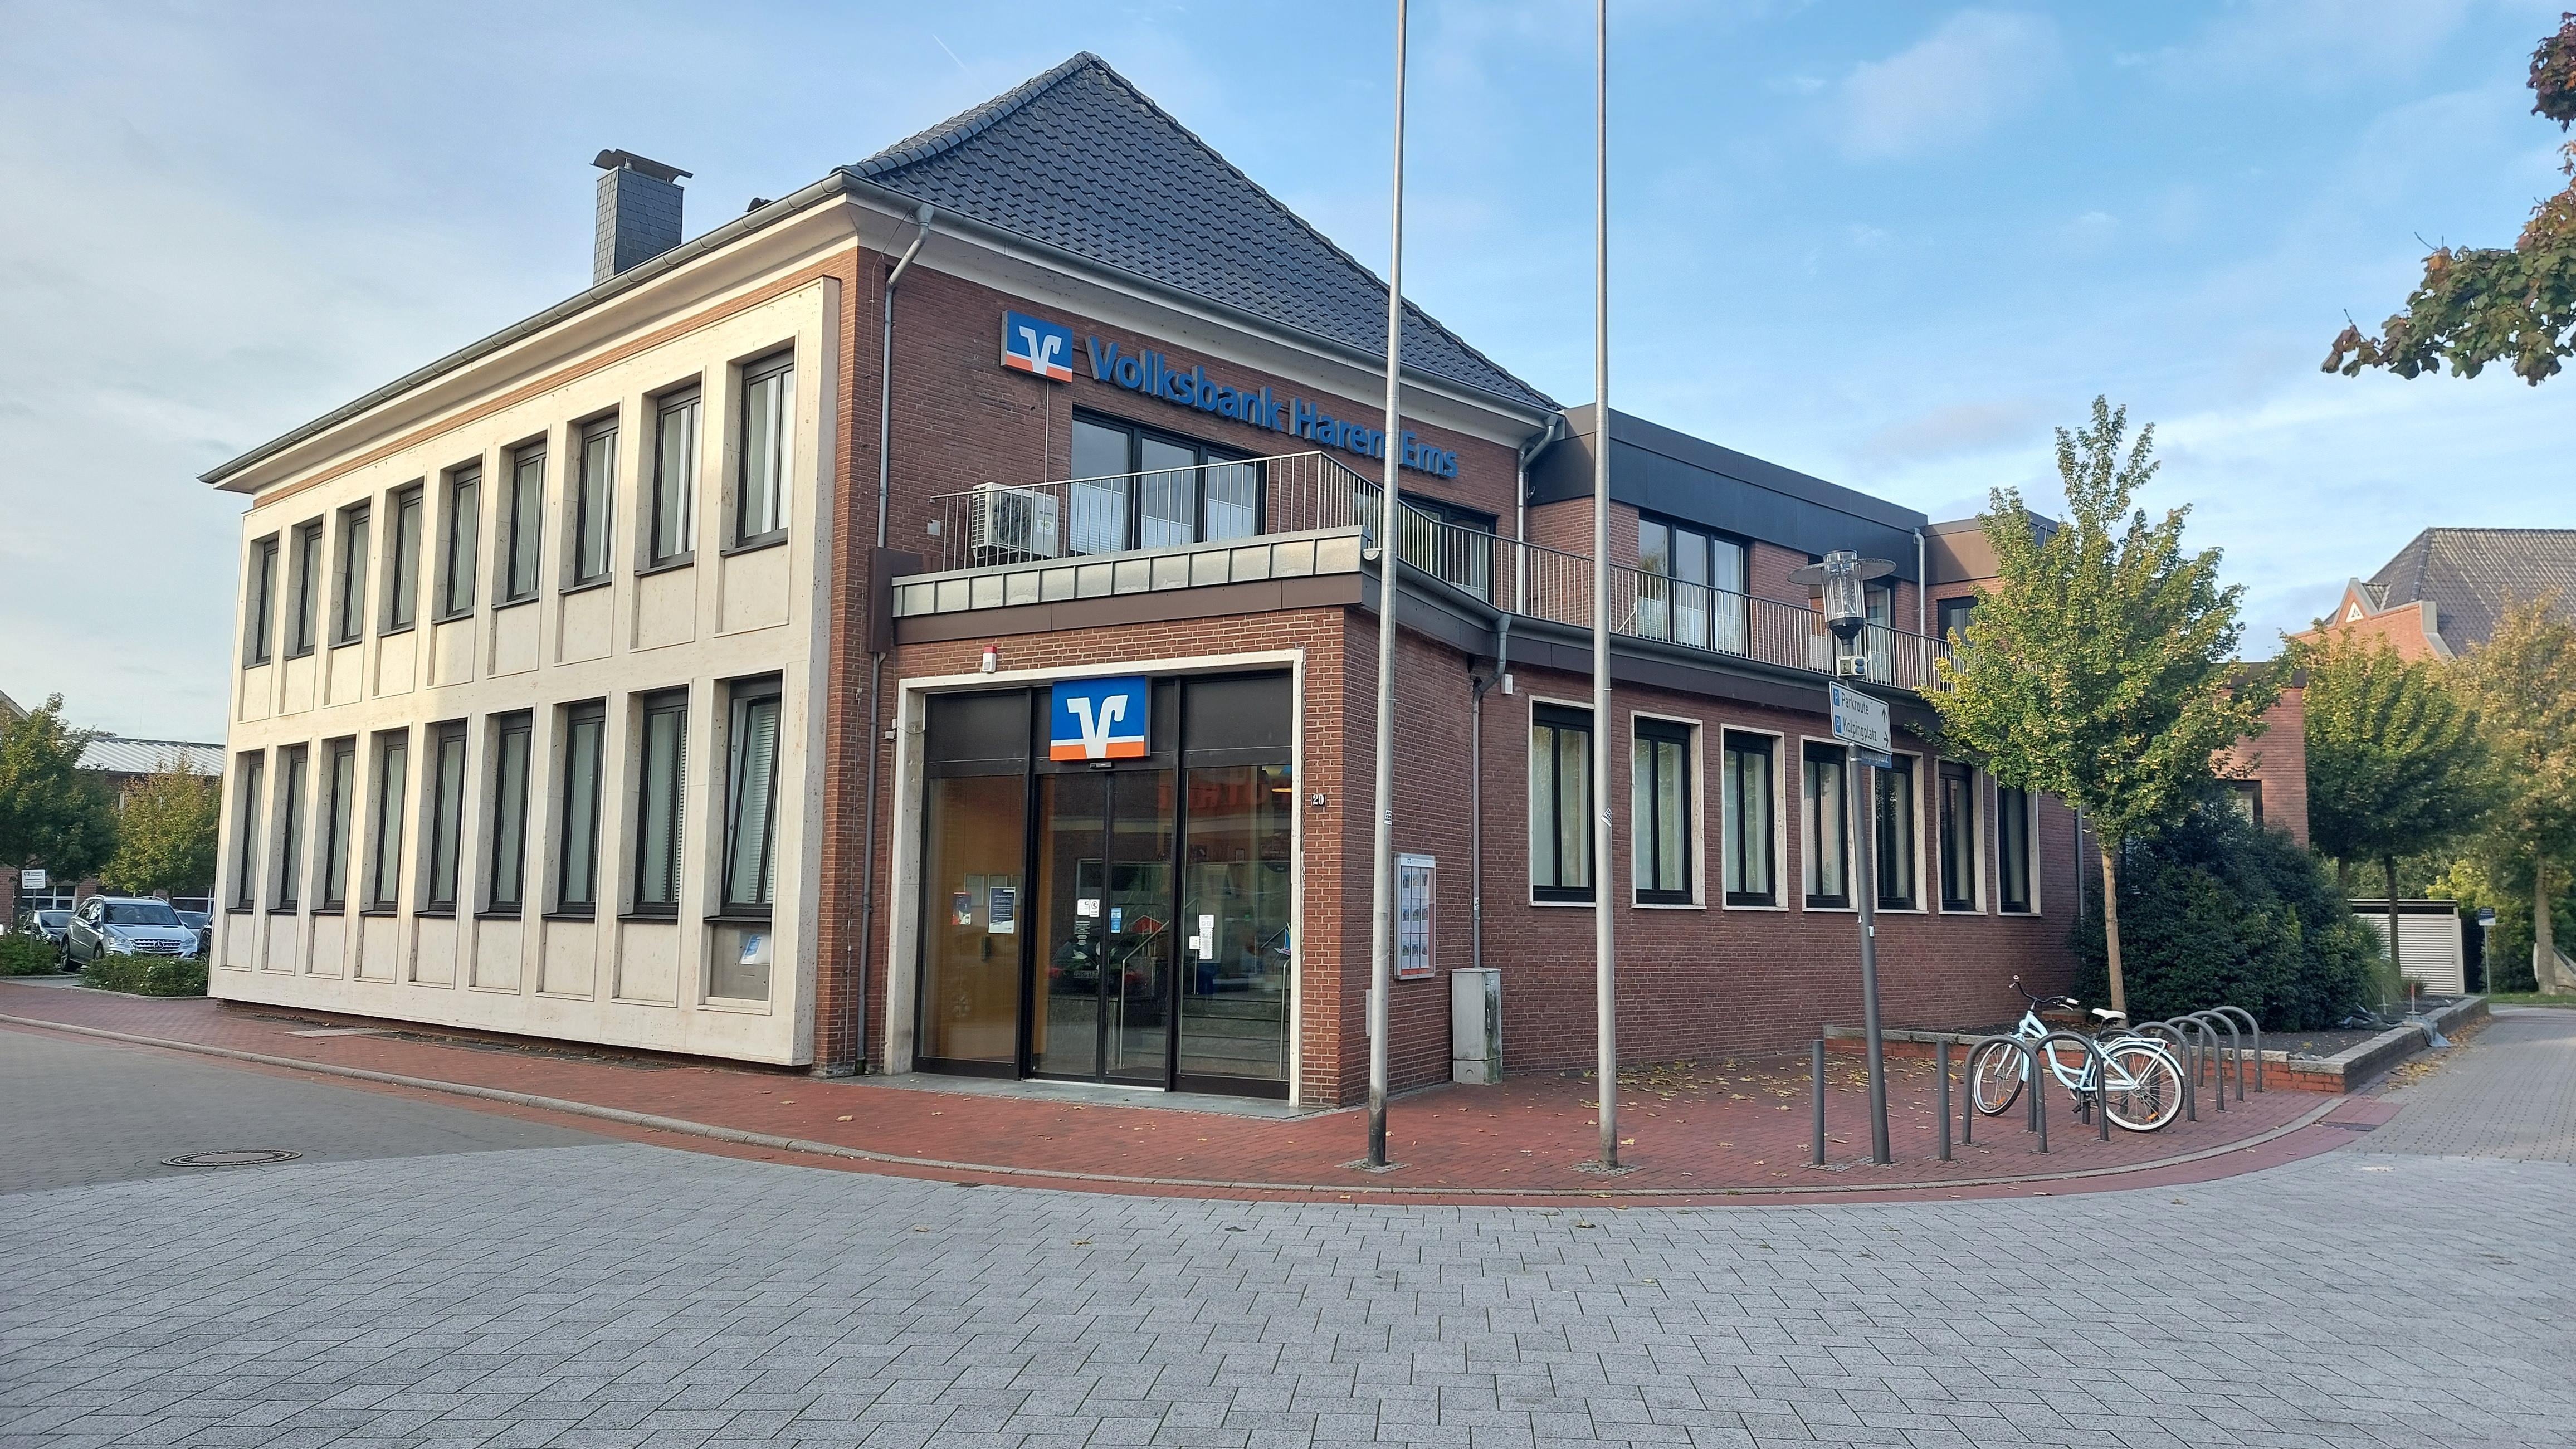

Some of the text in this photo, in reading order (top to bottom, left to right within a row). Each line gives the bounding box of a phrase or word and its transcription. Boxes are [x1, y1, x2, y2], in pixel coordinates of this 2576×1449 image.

[1085, 335, 1458, 478] Volksbank Haren Ems
[1841, 691, 1869, 715] Parkroute
[1843, 716, 1877, 741] Kolpingplatz
[1313, 794, 1324, 806] 20
